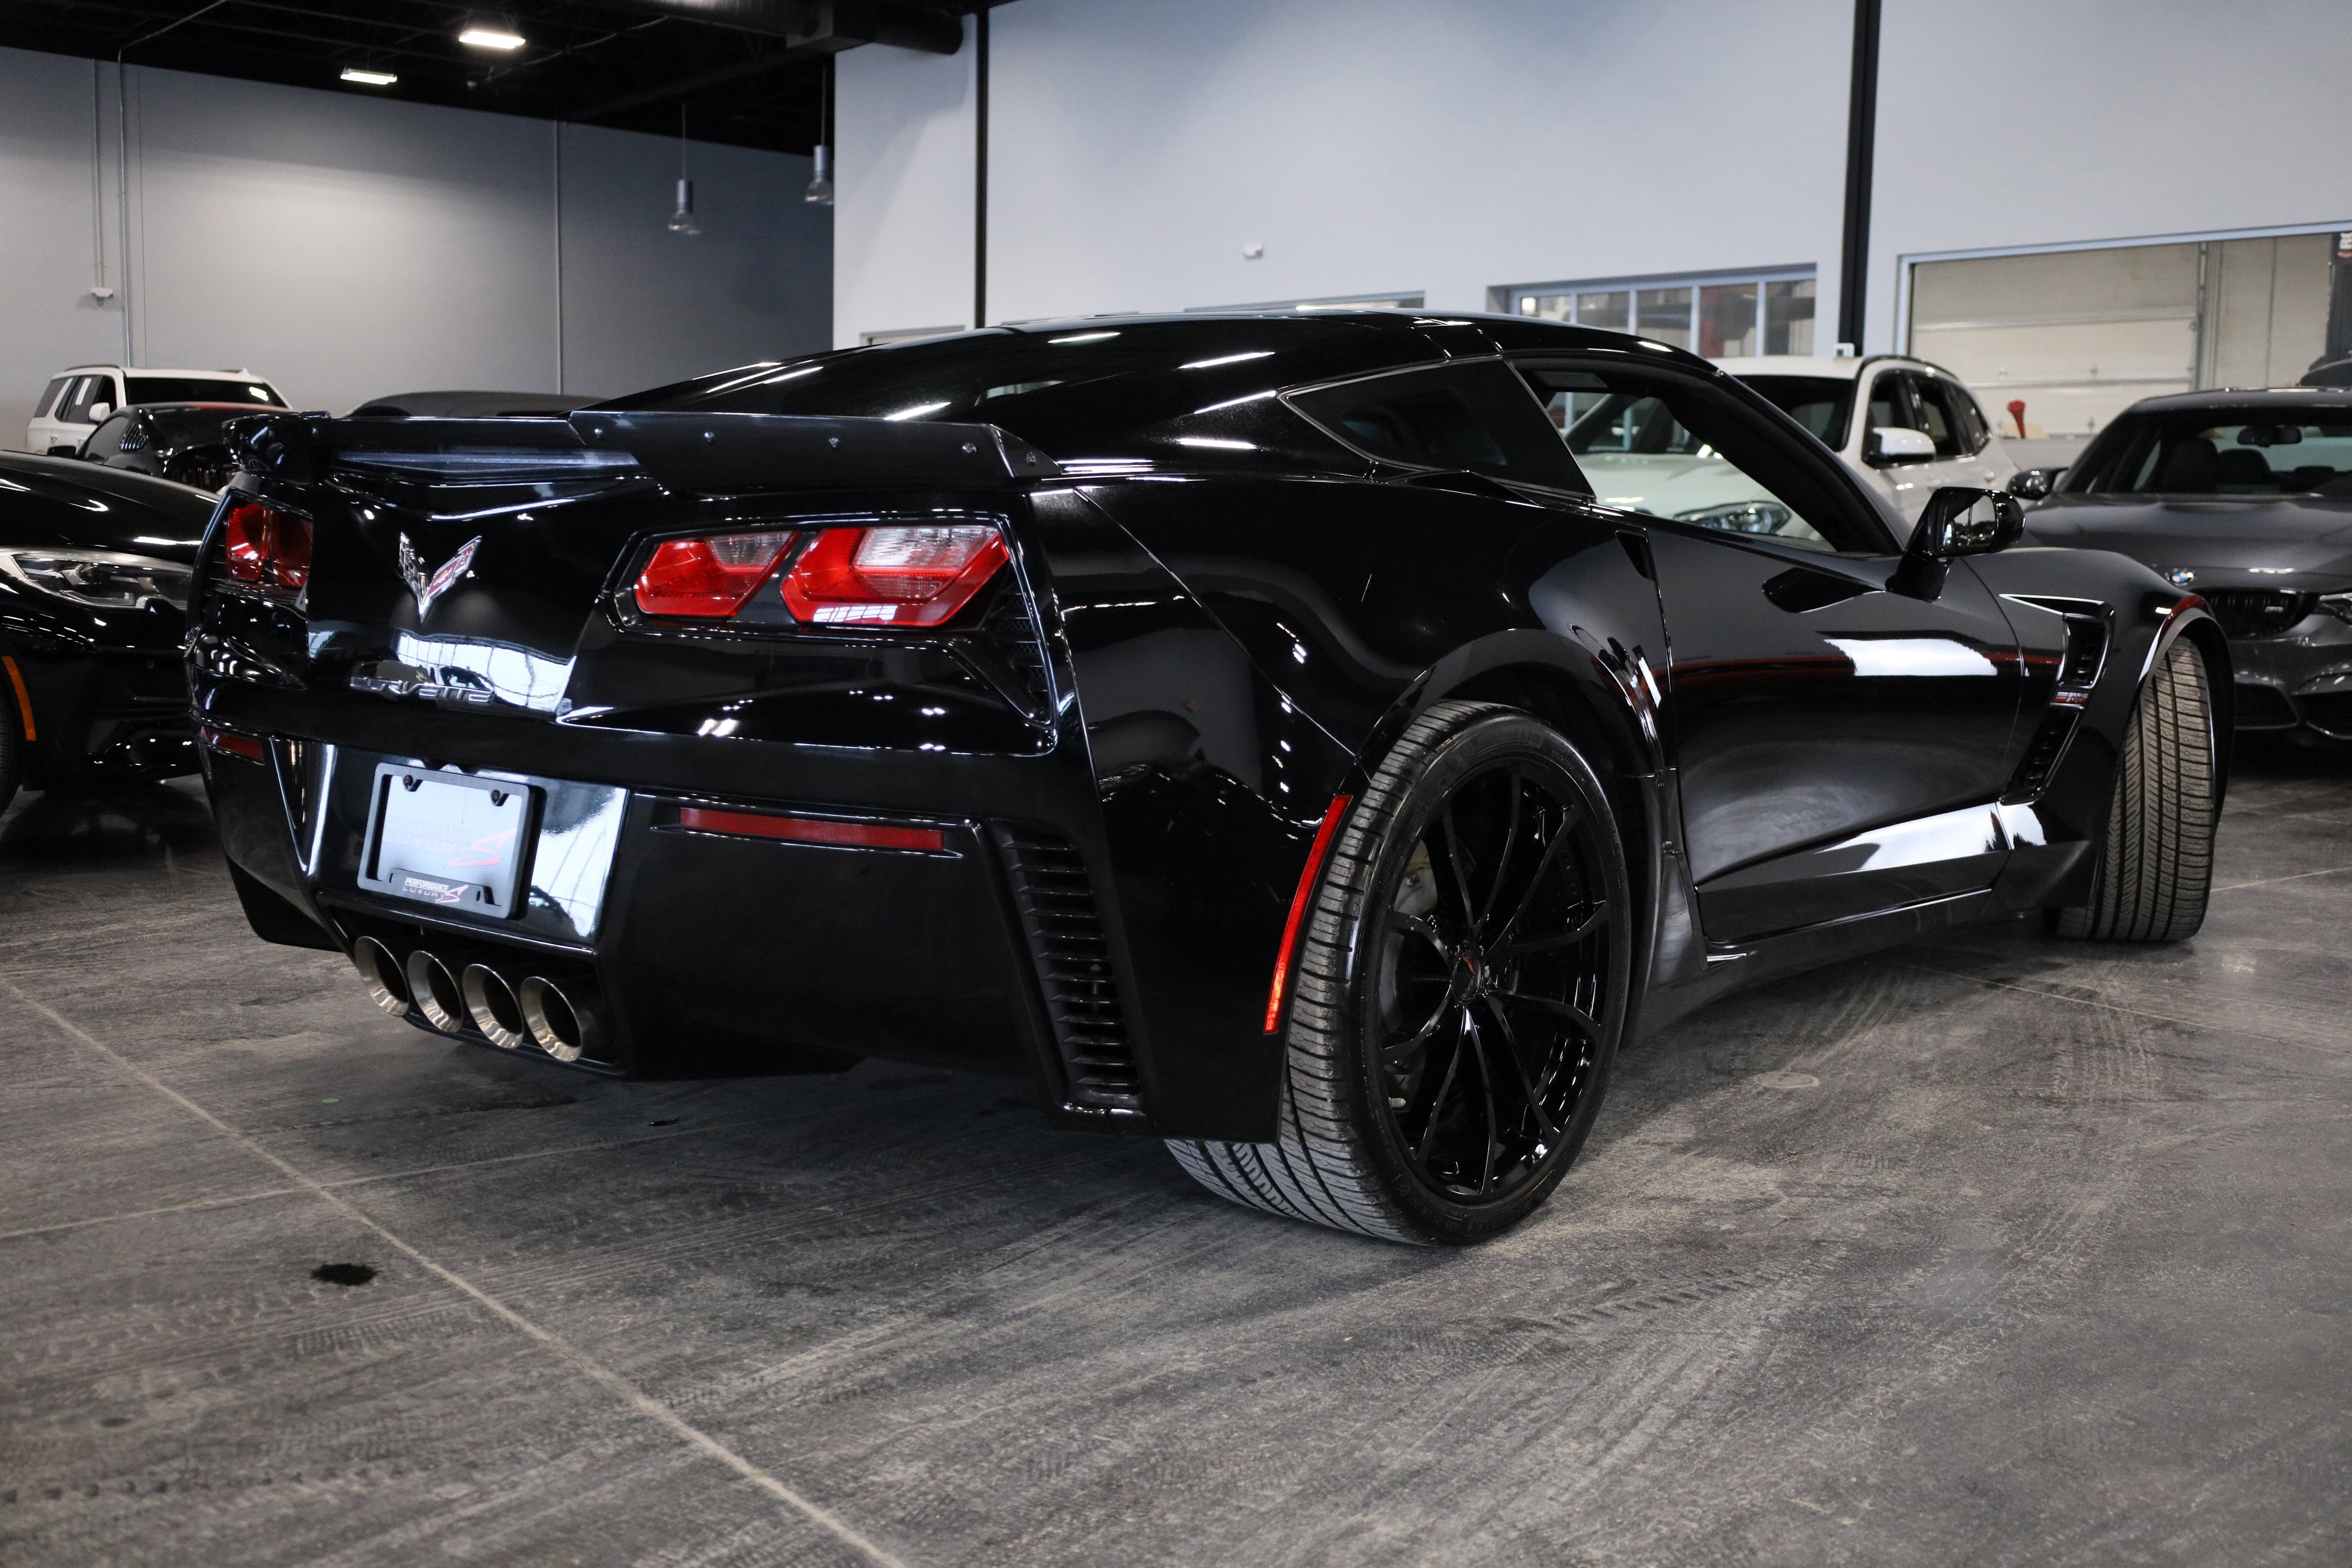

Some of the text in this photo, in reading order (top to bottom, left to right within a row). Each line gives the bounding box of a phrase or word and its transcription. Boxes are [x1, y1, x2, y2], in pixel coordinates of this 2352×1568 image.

[386, 815, 476, 843] PERFORMANCE
[382, 833, 471, 854] LUXURY
[403, 886, 446, 898] LUXURY
[405, 877, 449, 892] PERFORMANCE
